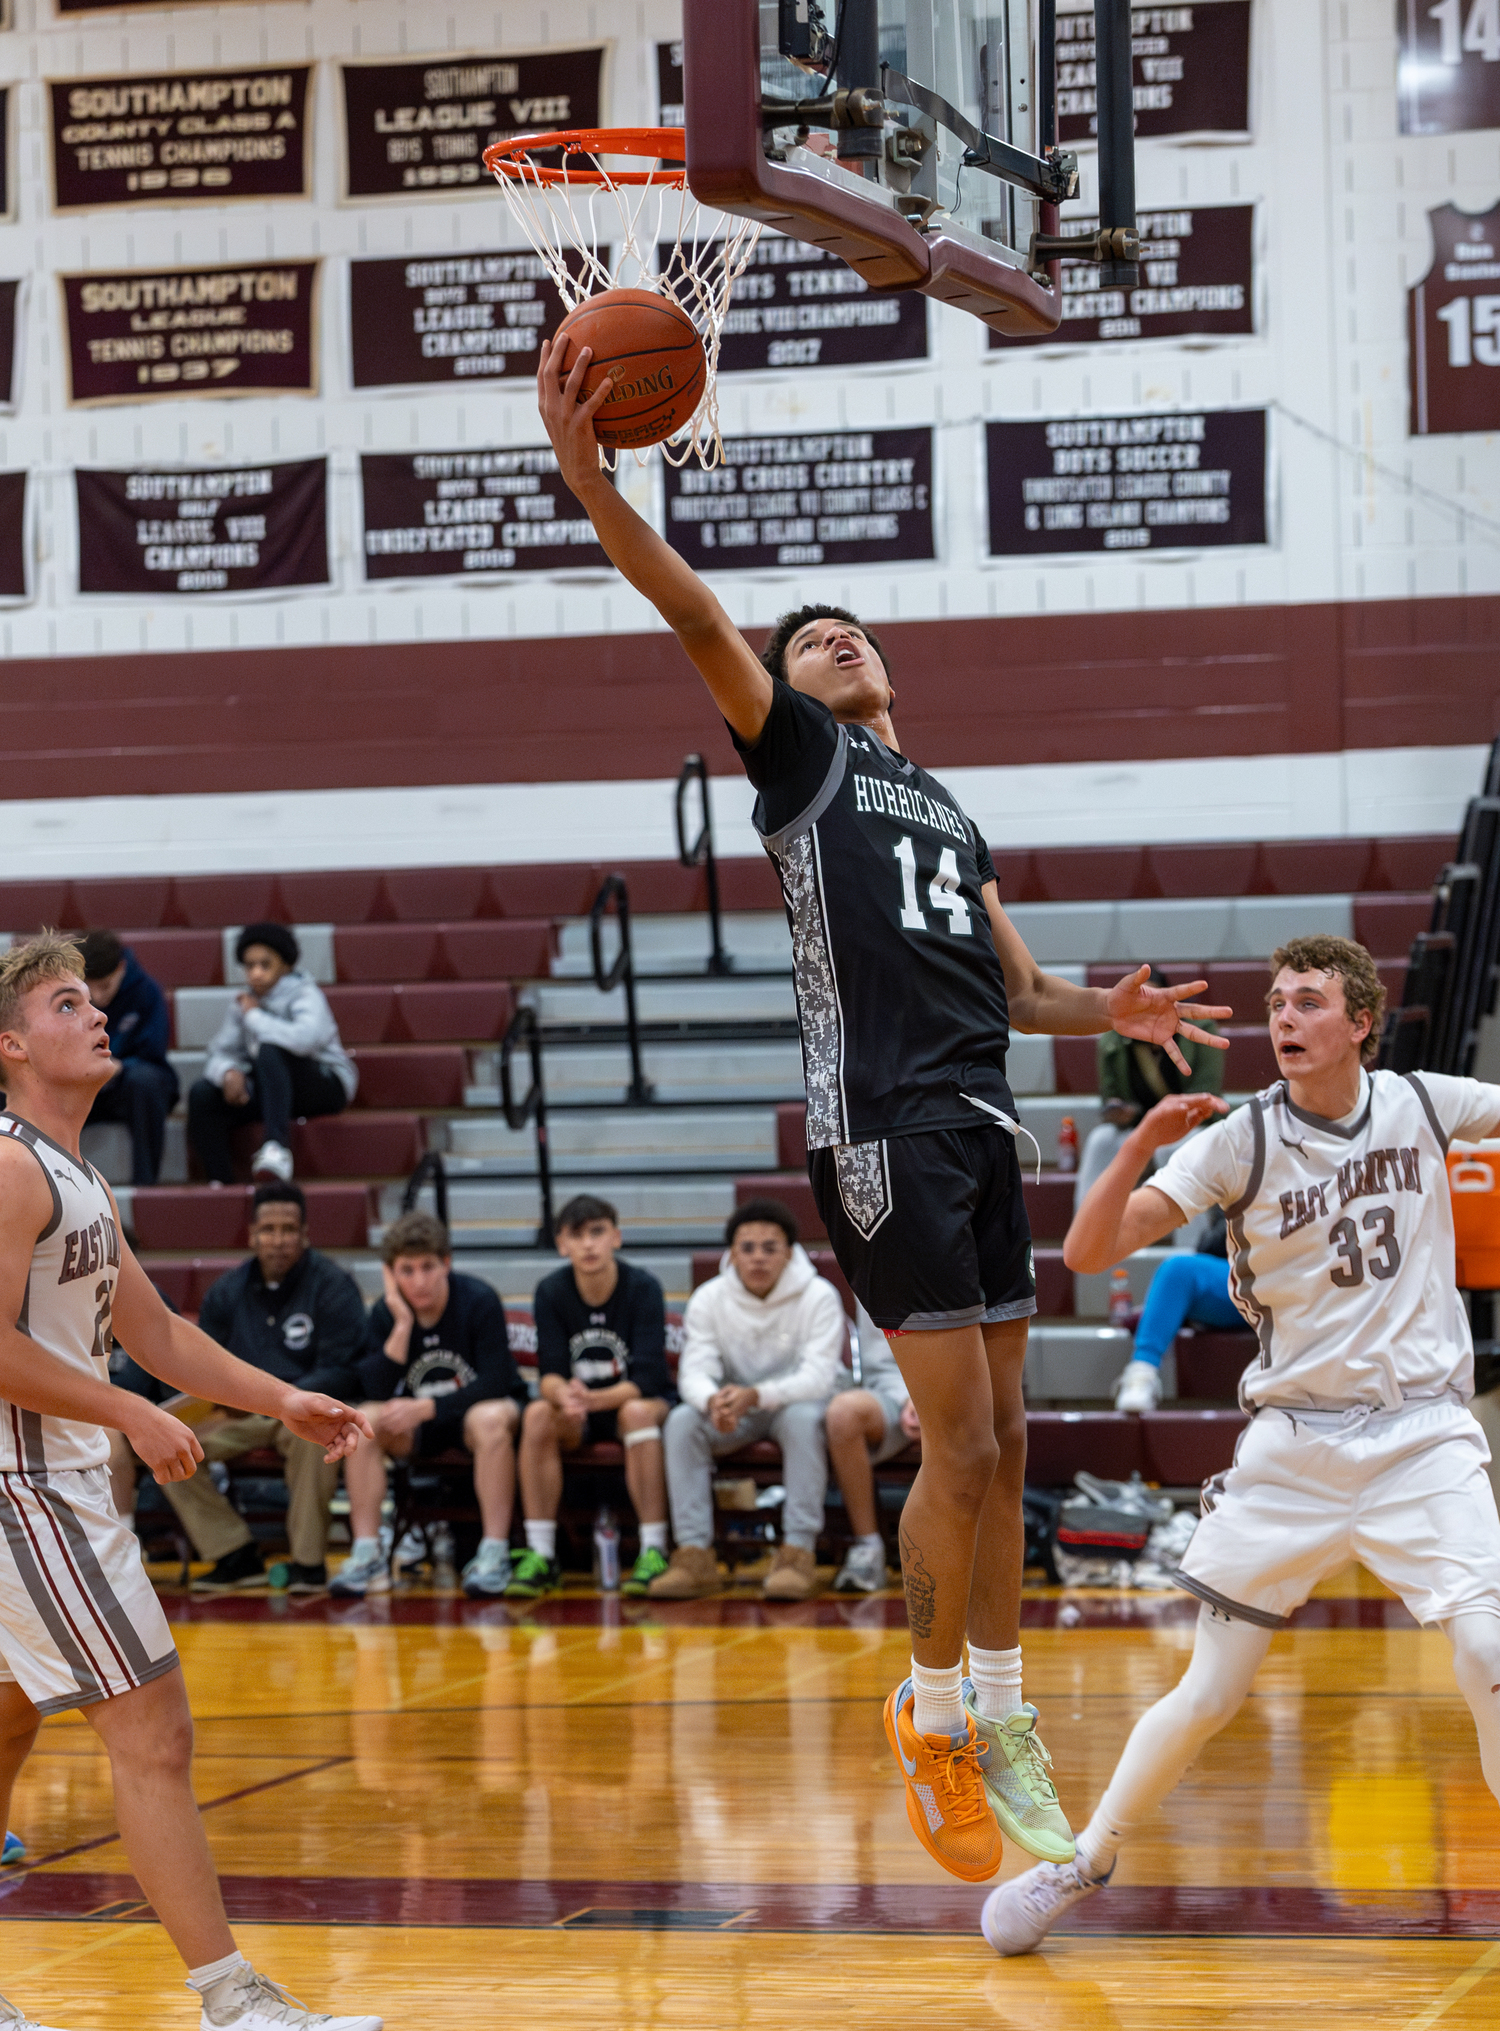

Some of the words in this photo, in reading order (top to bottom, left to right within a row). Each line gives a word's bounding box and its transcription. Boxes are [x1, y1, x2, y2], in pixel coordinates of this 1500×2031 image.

[69, 76, 292, 119] SOUTHAMPTON
[424, 63, 519, 99] SOUTHAMPTON
[61, 118, 173, 144] COUNTY
[177, 112, 272, 135] CLASS
[375, 101, 497, 133] LEAGUE
[75, 143, 154, 171] TENNIS
[160, 135, 287, 165] CHAMPIONS
[80, 271, 298, 313] SOUTHAMPTON
[1130, 284, 1245, 315] CHAMPIONS
[130, 306, 247, 331] LEAGUE
[413, 303, 495, 333] LEAGUE
[1436, 294, 1500, 368] 15
[87, 335, 165, 364] TENNIS
[170, 328, 294, 357] CHAMPIONS
[422, 327, 538, 358] CHAMPIONS
[137, 357, 241, 384] 1937
[1045, 415, 1206, 449] SOUTHAMPTON
[813, 457, 915, 489] COUNTRY
[1053, 446, 1113, 475] BOYS
[1114, 442, 1201, 473] SOCCER
[125, 469, 273, 500] SOUTHAMPTON
[423, 496, 505, 526] LEAGUE
[136, 518, 216, 545] LEAGUE
[366, 522, 495, 556] UNDEFEATED
[144, 541, 260, 571] CHAMPIONS
[853, 773, 968, 845] HURRICANES
[893, 834, 974, 936] 14
[1279, 1178, 1332, 1241] EAST
[57, 1219, 104, 1286] EAST
[1328, 1204, 1401, 1288] 33
